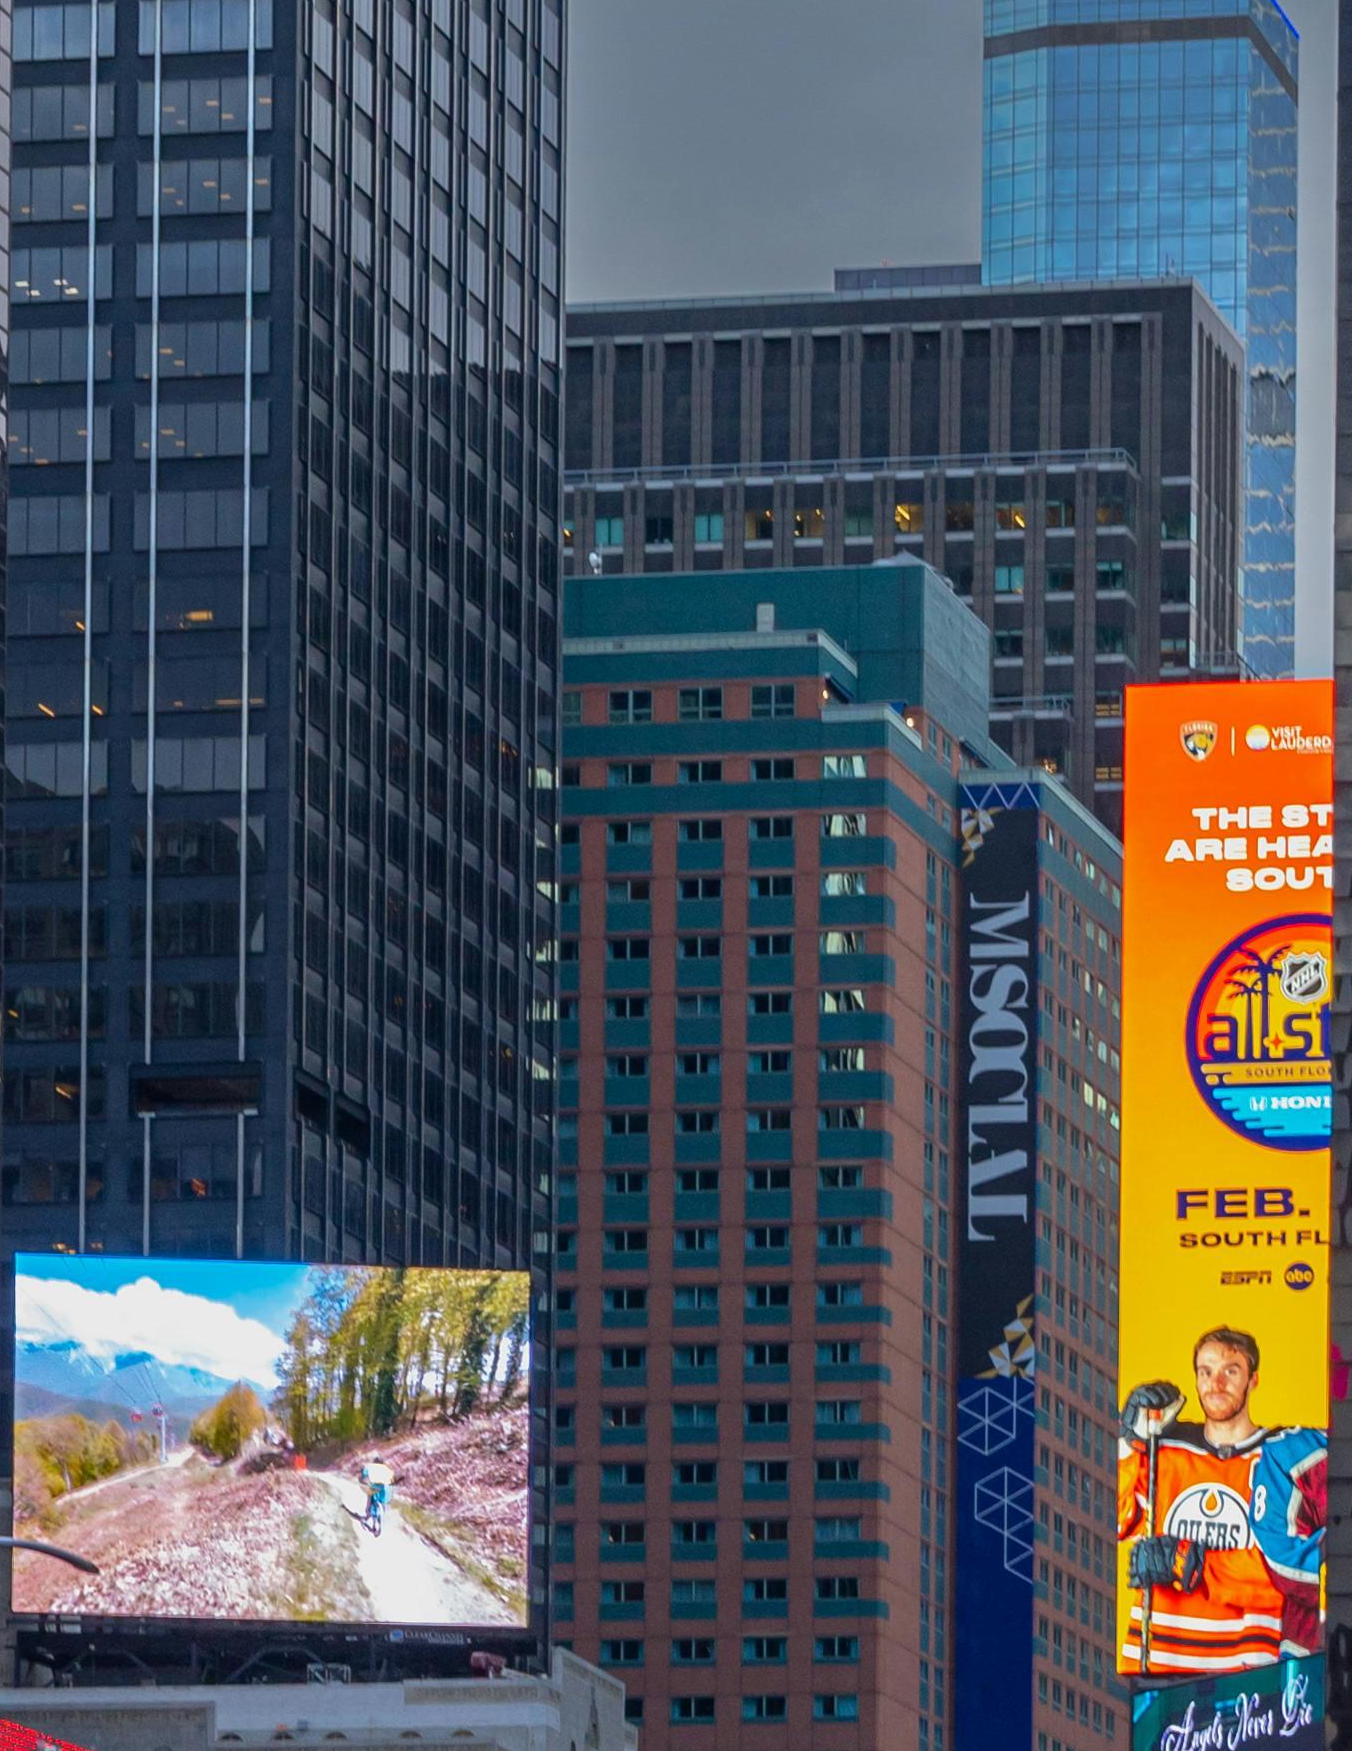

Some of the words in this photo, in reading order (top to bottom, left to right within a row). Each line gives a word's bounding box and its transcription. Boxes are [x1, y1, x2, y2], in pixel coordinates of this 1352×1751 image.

[1191, 805, 1272, 831] THE
[1164, 838, 1248, 863] ARE
[1289, 965, 1320, 994] NHL
[1245, 1065, 1295, 1079] SOUTH
[1175, 1188, 1311, 1221] FEB.
[1179, 1231, 1287, 1249] SOUTH
[1220, 1270, 1272, 1286] ESPN
[1286, 1267, 1314, 1286] abc
